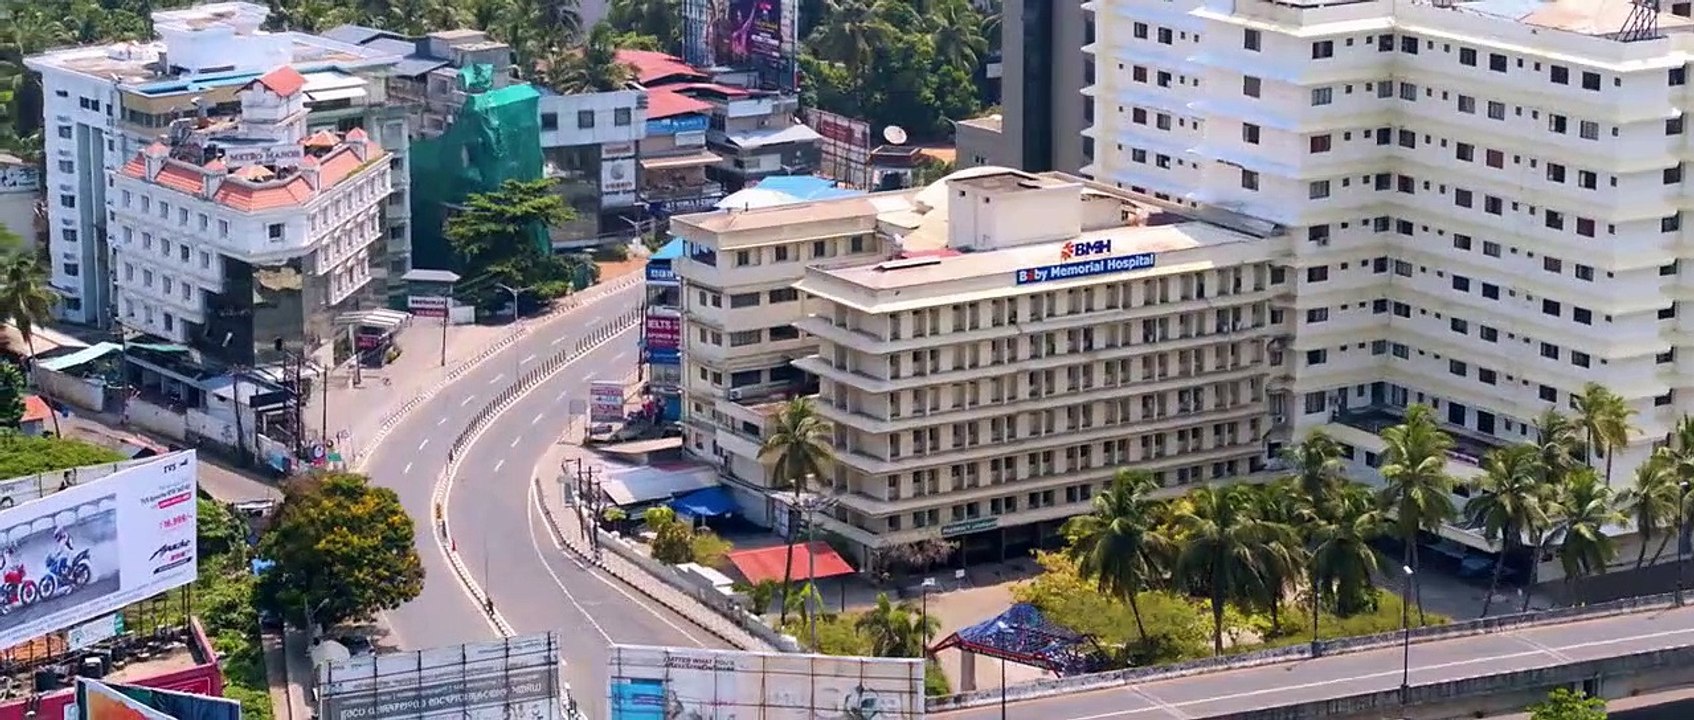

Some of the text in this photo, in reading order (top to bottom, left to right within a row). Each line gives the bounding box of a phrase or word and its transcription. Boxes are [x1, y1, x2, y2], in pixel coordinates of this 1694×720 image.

[1074, 239, 1111, 257] BMH
[1051, 260, 1104, 277] Memorial
[1107, 254, 1154, 271] Hospital
